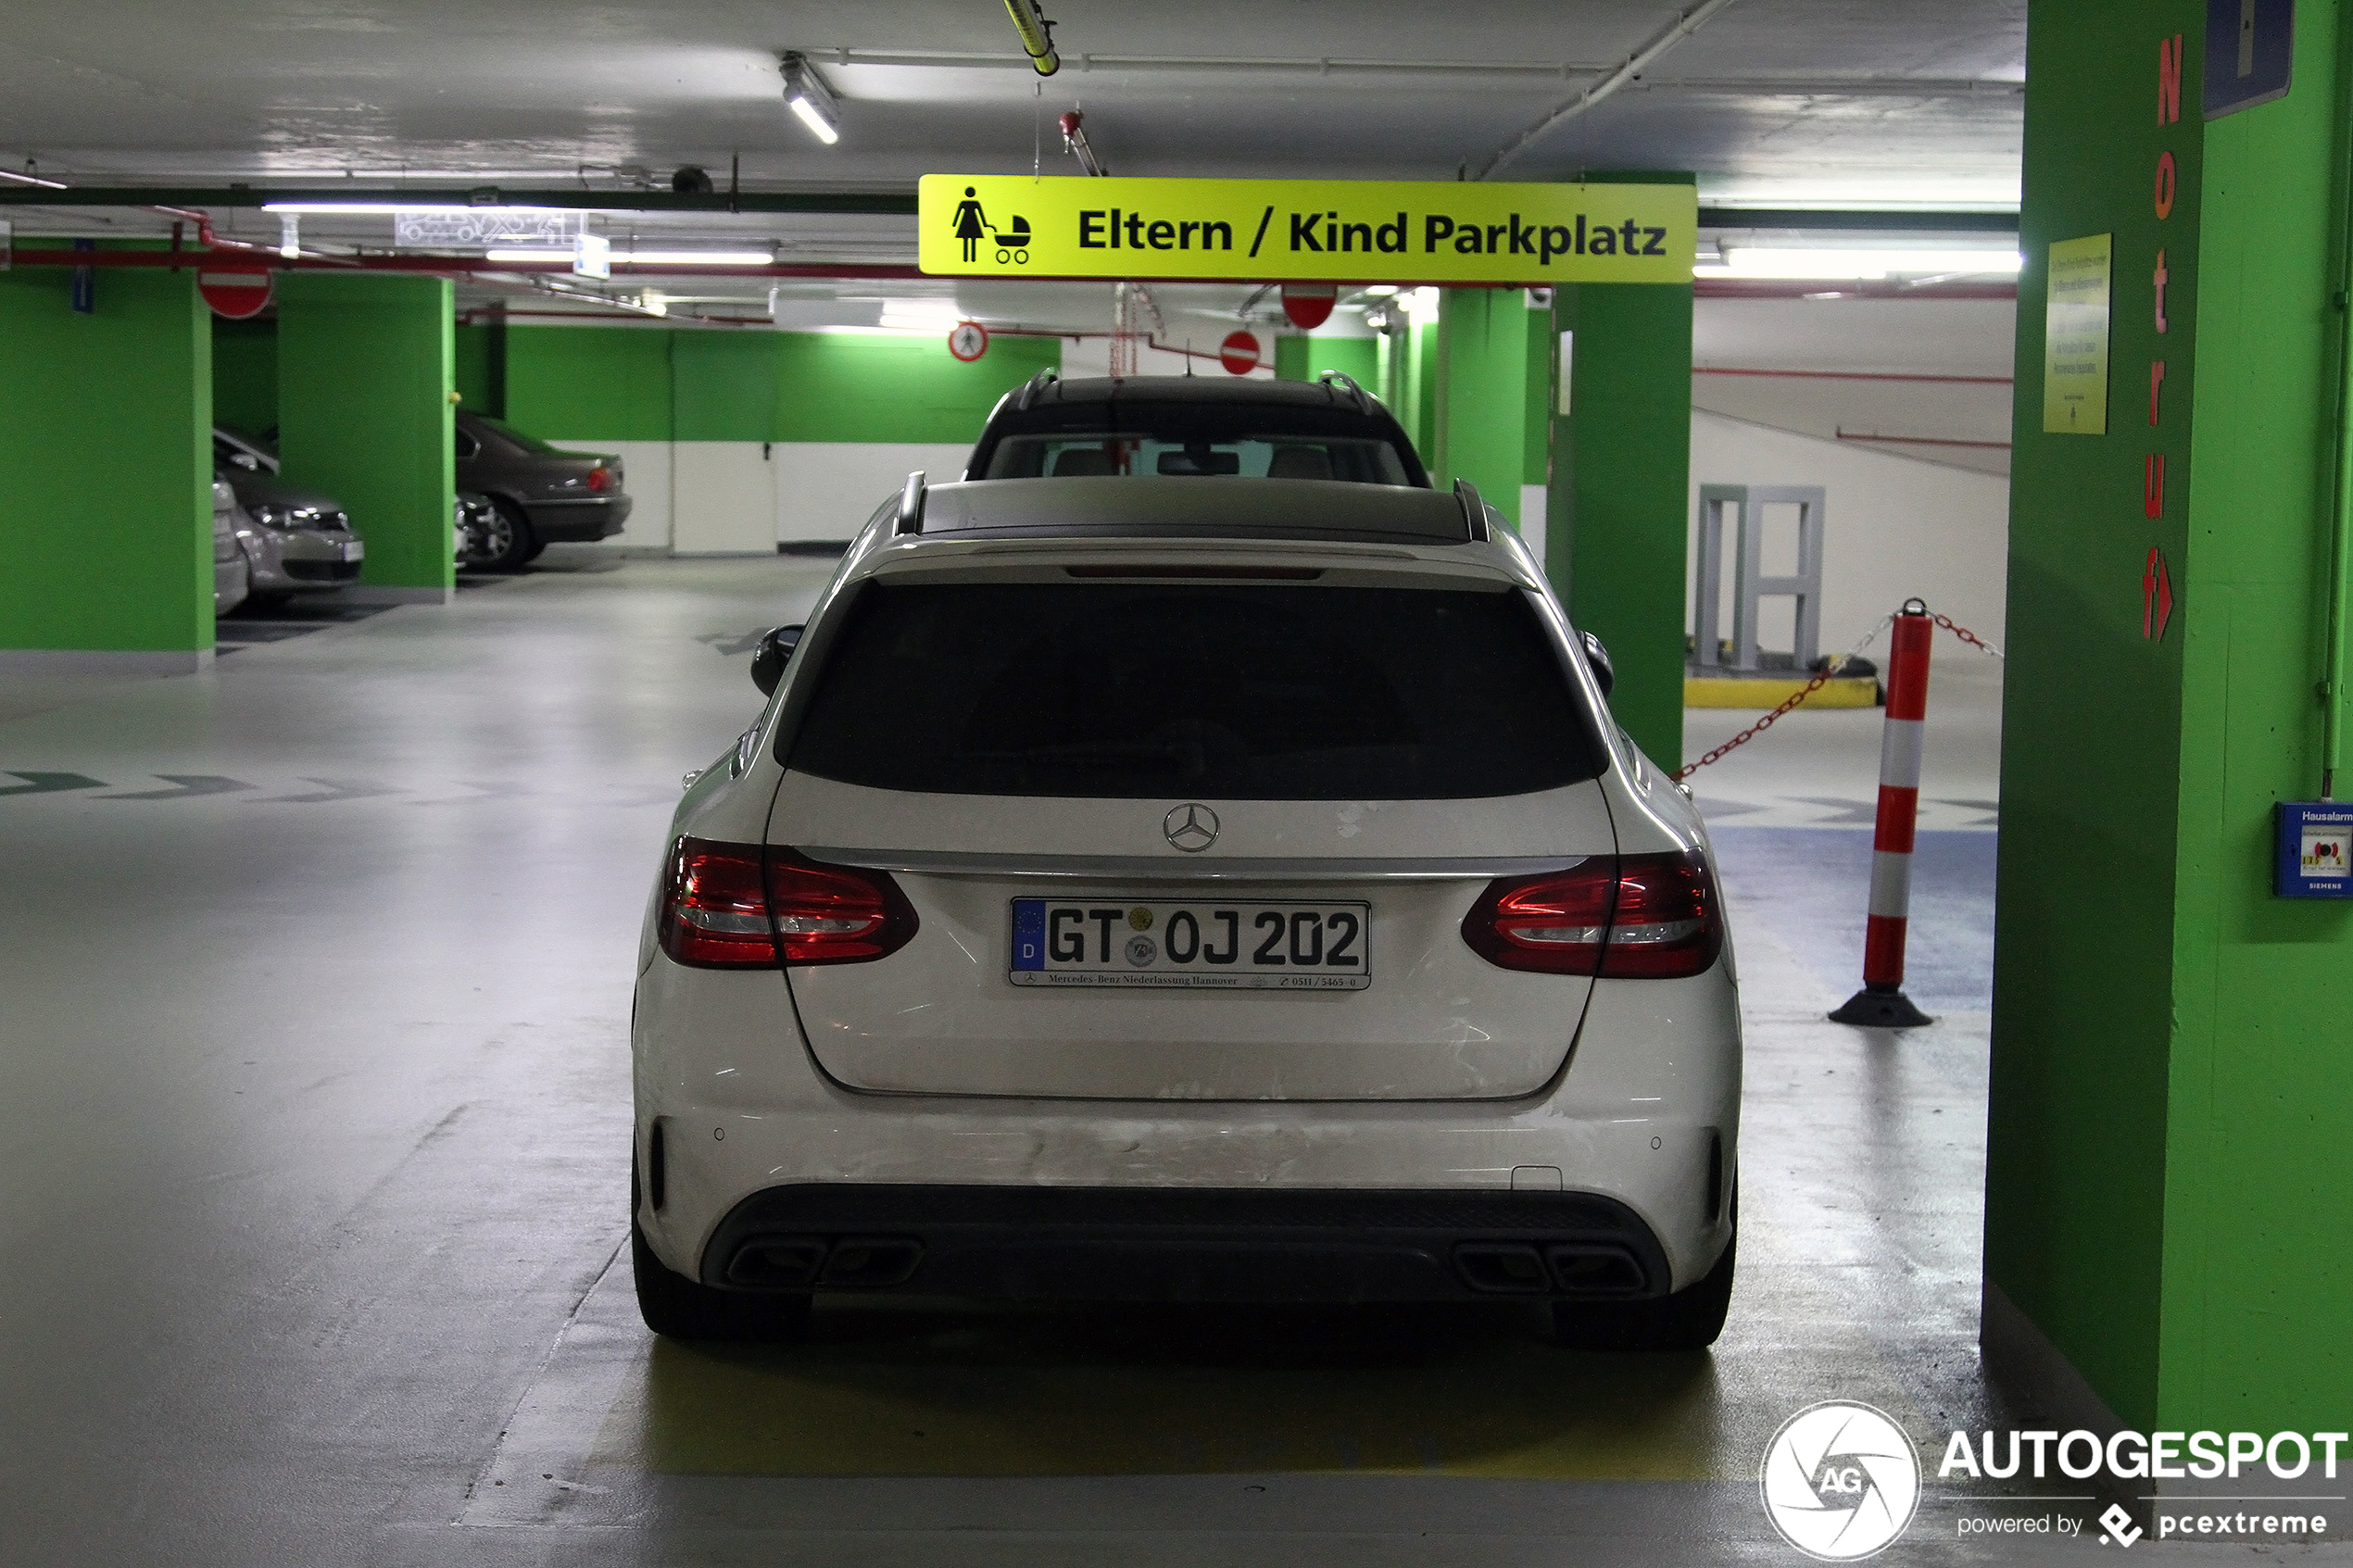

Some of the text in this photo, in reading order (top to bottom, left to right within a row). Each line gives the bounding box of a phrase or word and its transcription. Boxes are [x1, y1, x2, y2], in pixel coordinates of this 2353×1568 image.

[1079, 206, 1667, 265] Eltern / Kind Parkplatz
[2142, 33, 2183, 639] Notruf
[2302, 811, 2353, 822] Hausalarm
[1049, 909, 1124, 963] GT
[1165, 910, 1239, 964] OJ
[1252, 912, 1360, 966] 202
[1023, 945, 1034, 958] D
[1050, 974, 1239, 985] Mercedes-Benz Niederlassung Hannover
[1292, 978, 1312, 986] 0511
